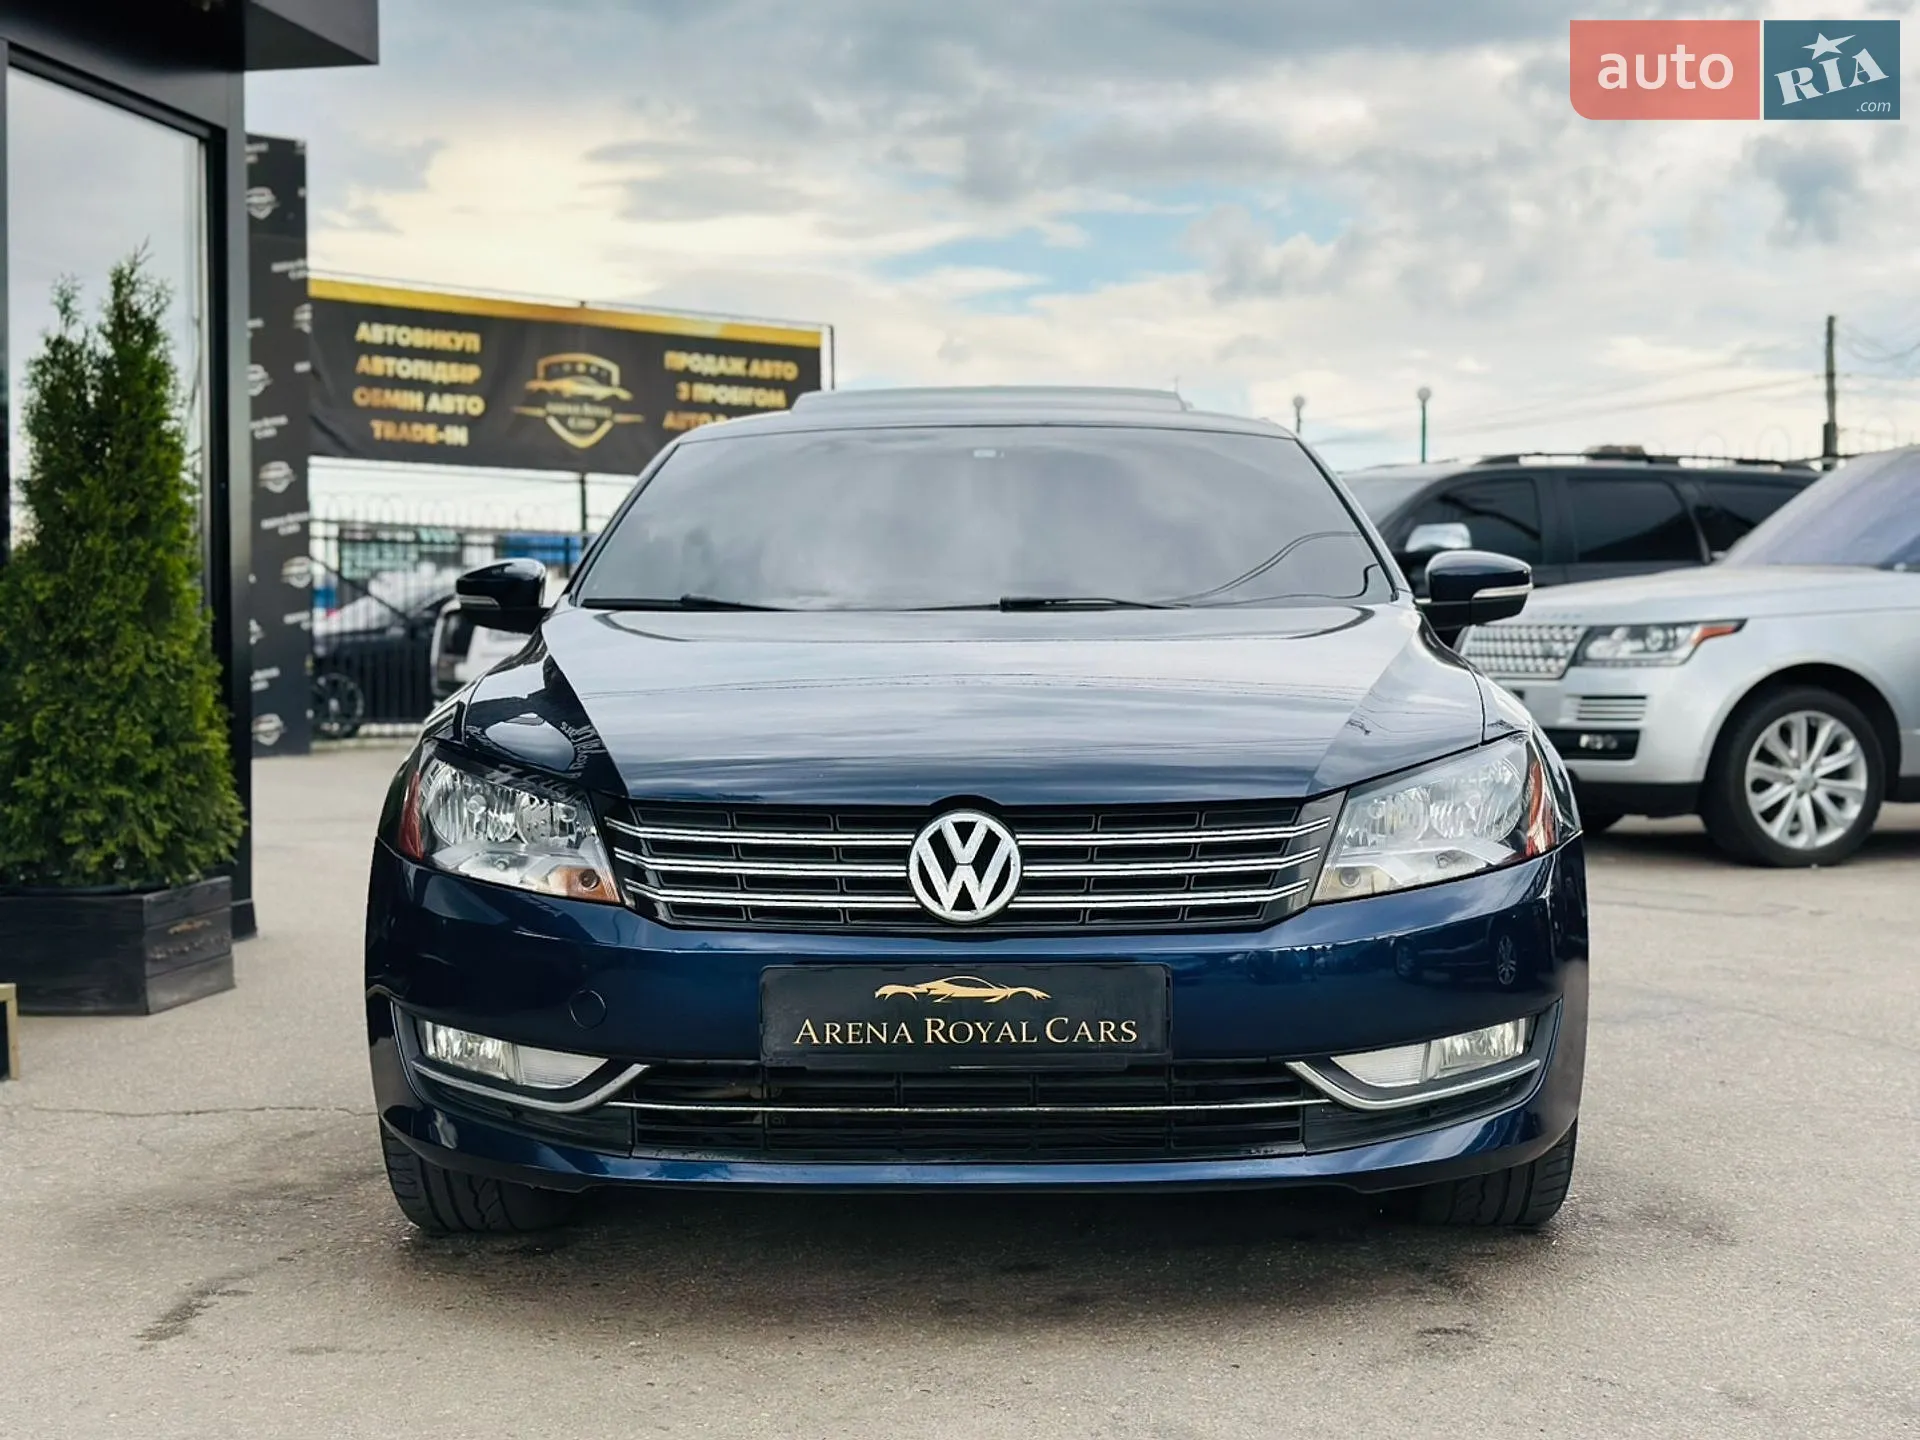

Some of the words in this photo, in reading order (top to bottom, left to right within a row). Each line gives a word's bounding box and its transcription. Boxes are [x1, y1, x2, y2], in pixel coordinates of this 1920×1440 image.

[355, 322, 481, 354] АВТОВИКУП
[749, 358, 799, 381] АВТО
[426, 392, 486, 416] АВТО
[370, 419, 469, 447] TRADE-IN
[911, 812, 1019, 919] VW
[924, 1018, 1038, 1045] ROYAL
[1045, 1016, 1138, 1044] CARS
